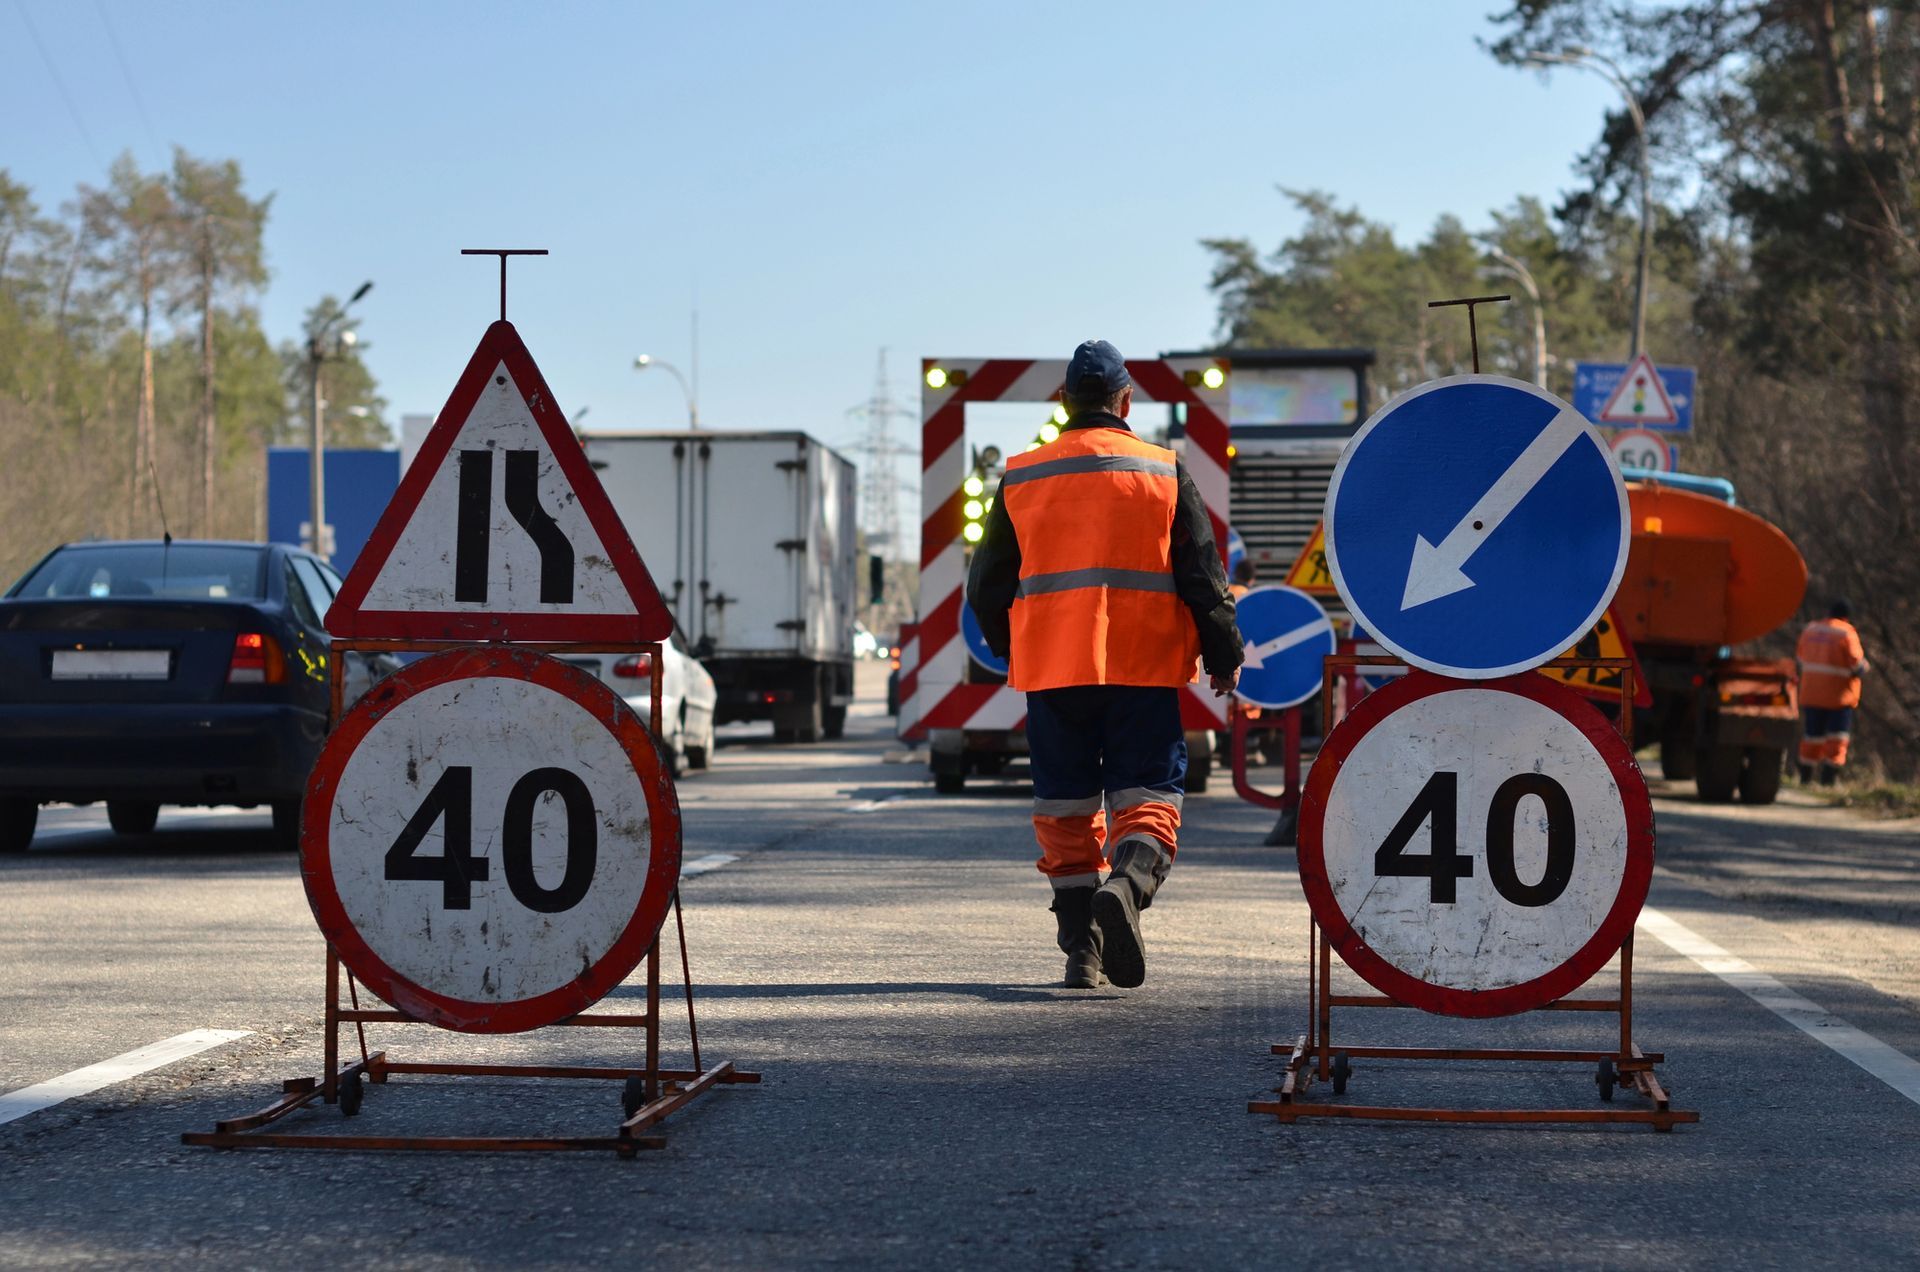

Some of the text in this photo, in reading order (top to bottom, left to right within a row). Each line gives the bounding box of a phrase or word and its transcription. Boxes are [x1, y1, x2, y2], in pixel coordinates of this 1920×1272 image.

[1620, 448, 1657, 470] 50
[385, 766, 598, 913] 40
[1375, 771, 1575, 907] 40
